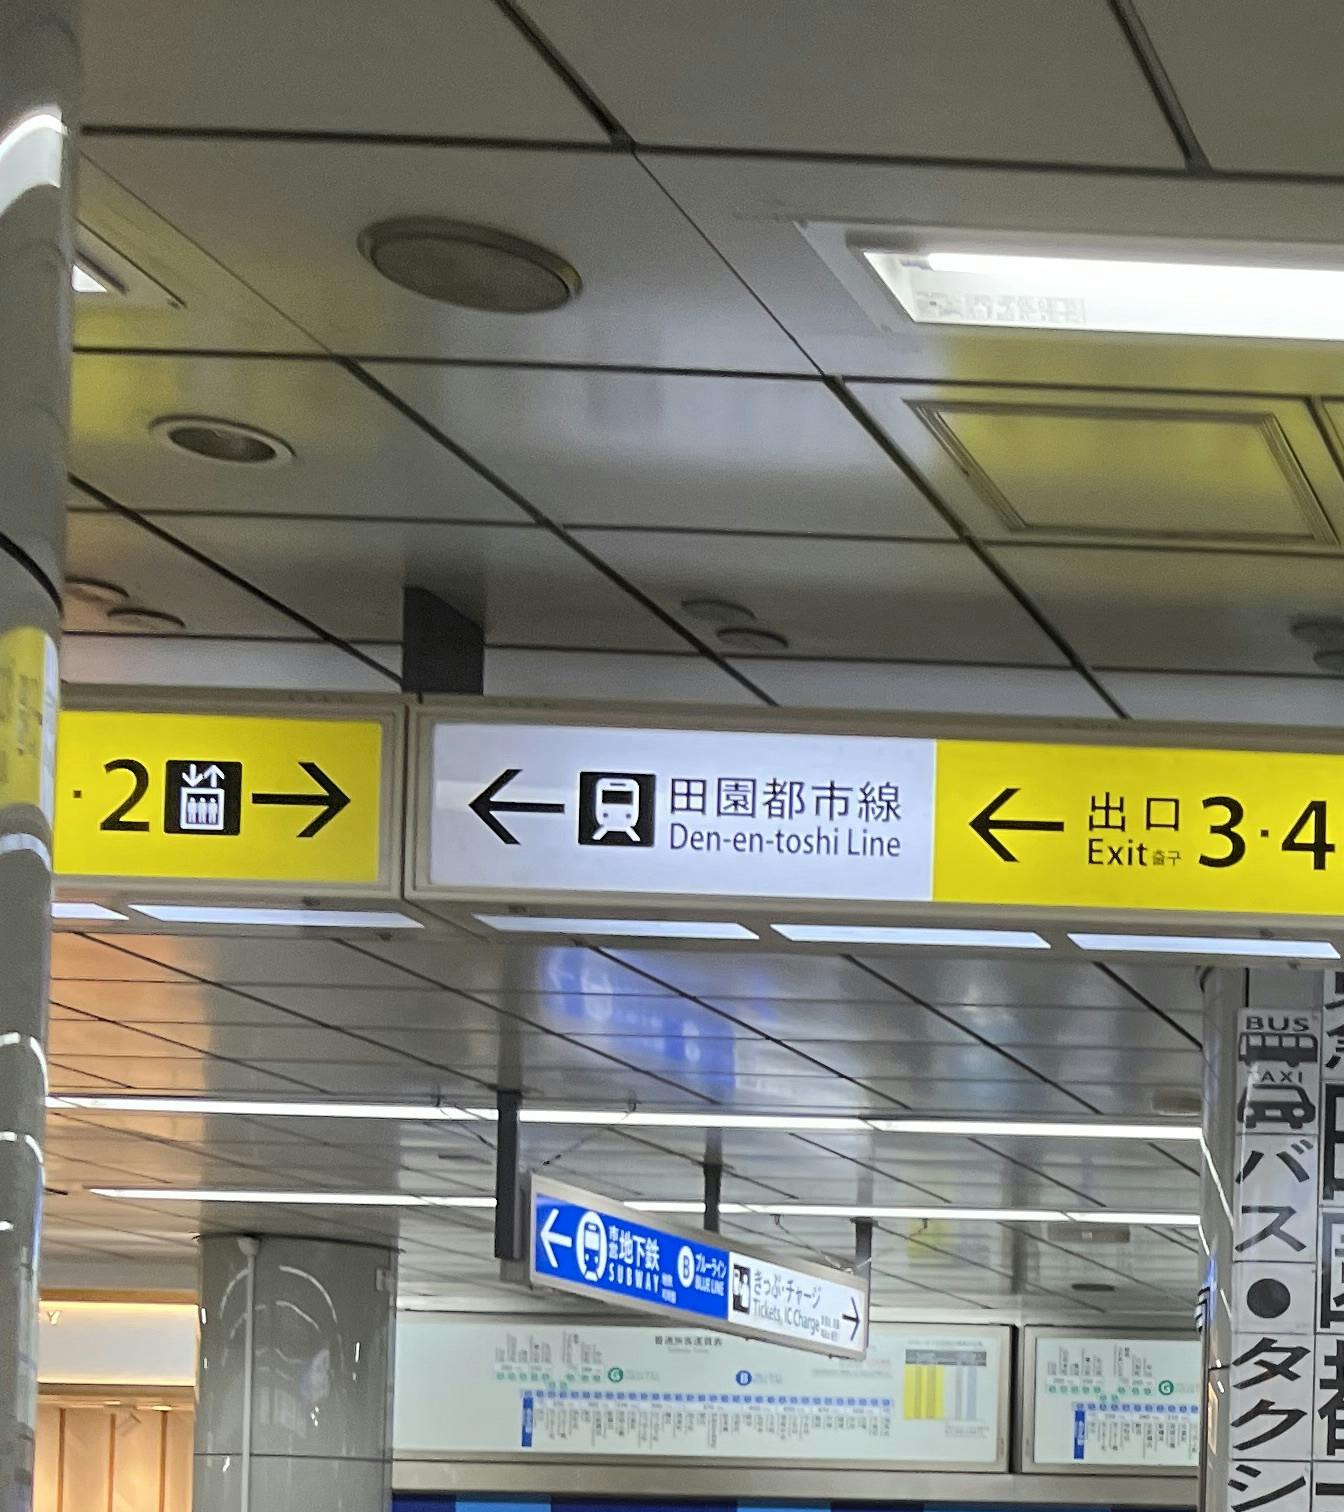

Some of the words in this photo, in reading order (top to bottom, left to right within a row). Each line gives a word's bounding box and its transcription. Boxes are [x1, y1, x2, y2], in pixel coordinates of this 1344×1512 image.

[671, 777, 901, 823] 田園都市線
[1088, 791, 1180, 832] 出口
[670, 823, 839, 857] Den-en-toshi
[847, 826, 900, 858] Line
[1088, 838, 1148, 867] Exit
[1246, 1016, 1309, 1032] BUS
[1248, 1070, 1302, 1083] AXI
[608, 1261, 660, 1294] SUBWAY
[711, 1278, 725, 1297] LINE
[793, 1308, 820, 1336] Charge
